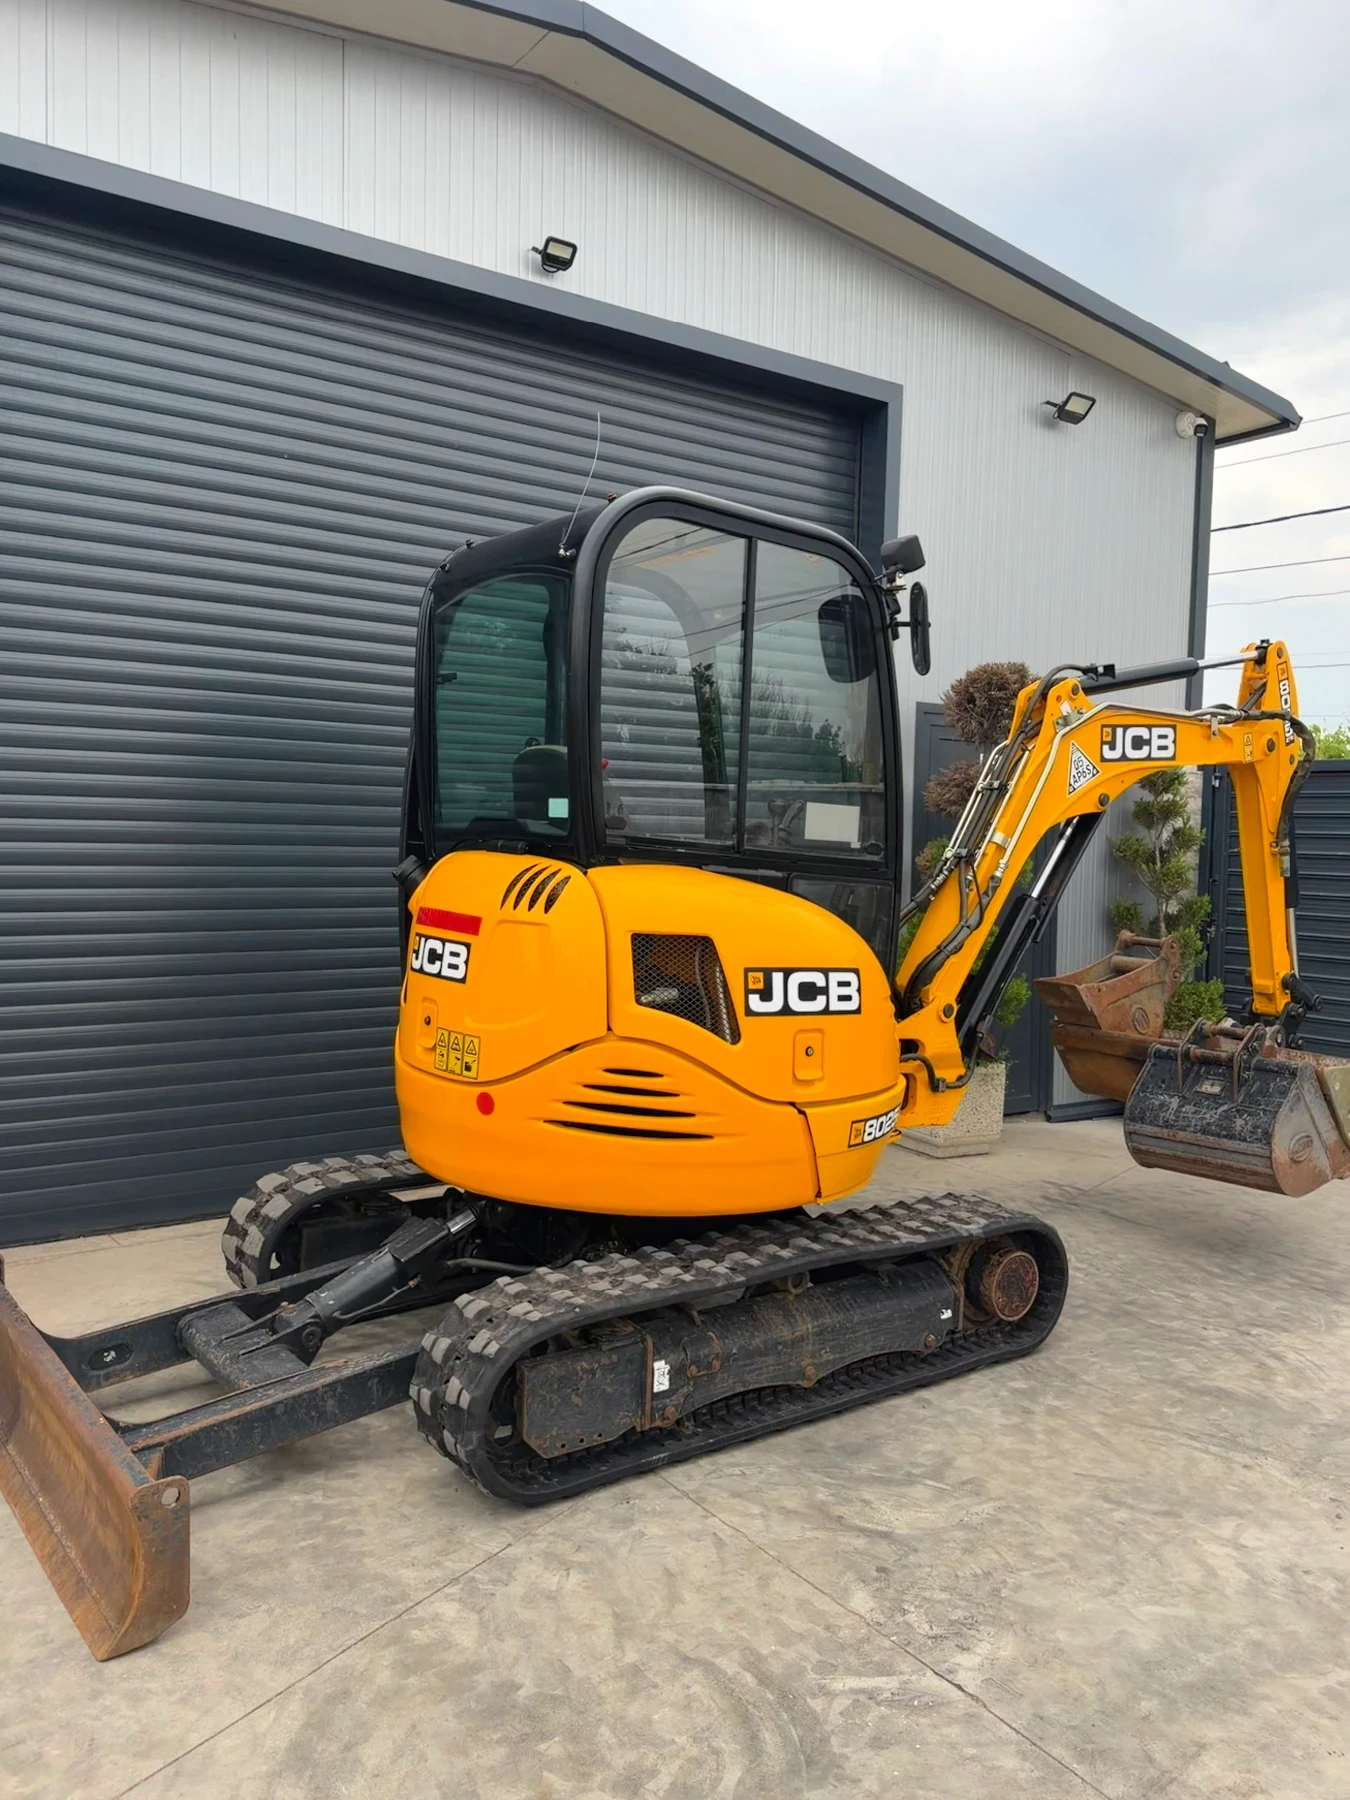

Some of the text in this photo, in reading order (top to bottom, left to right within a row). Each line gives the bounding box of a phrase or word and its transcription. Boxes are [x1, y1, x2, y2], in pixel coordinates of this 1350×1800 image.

[1102, 727, 1175, 760] JCB
[411, 936, 468, 979] JCB
[748, 971, 860, 1012] JCB
